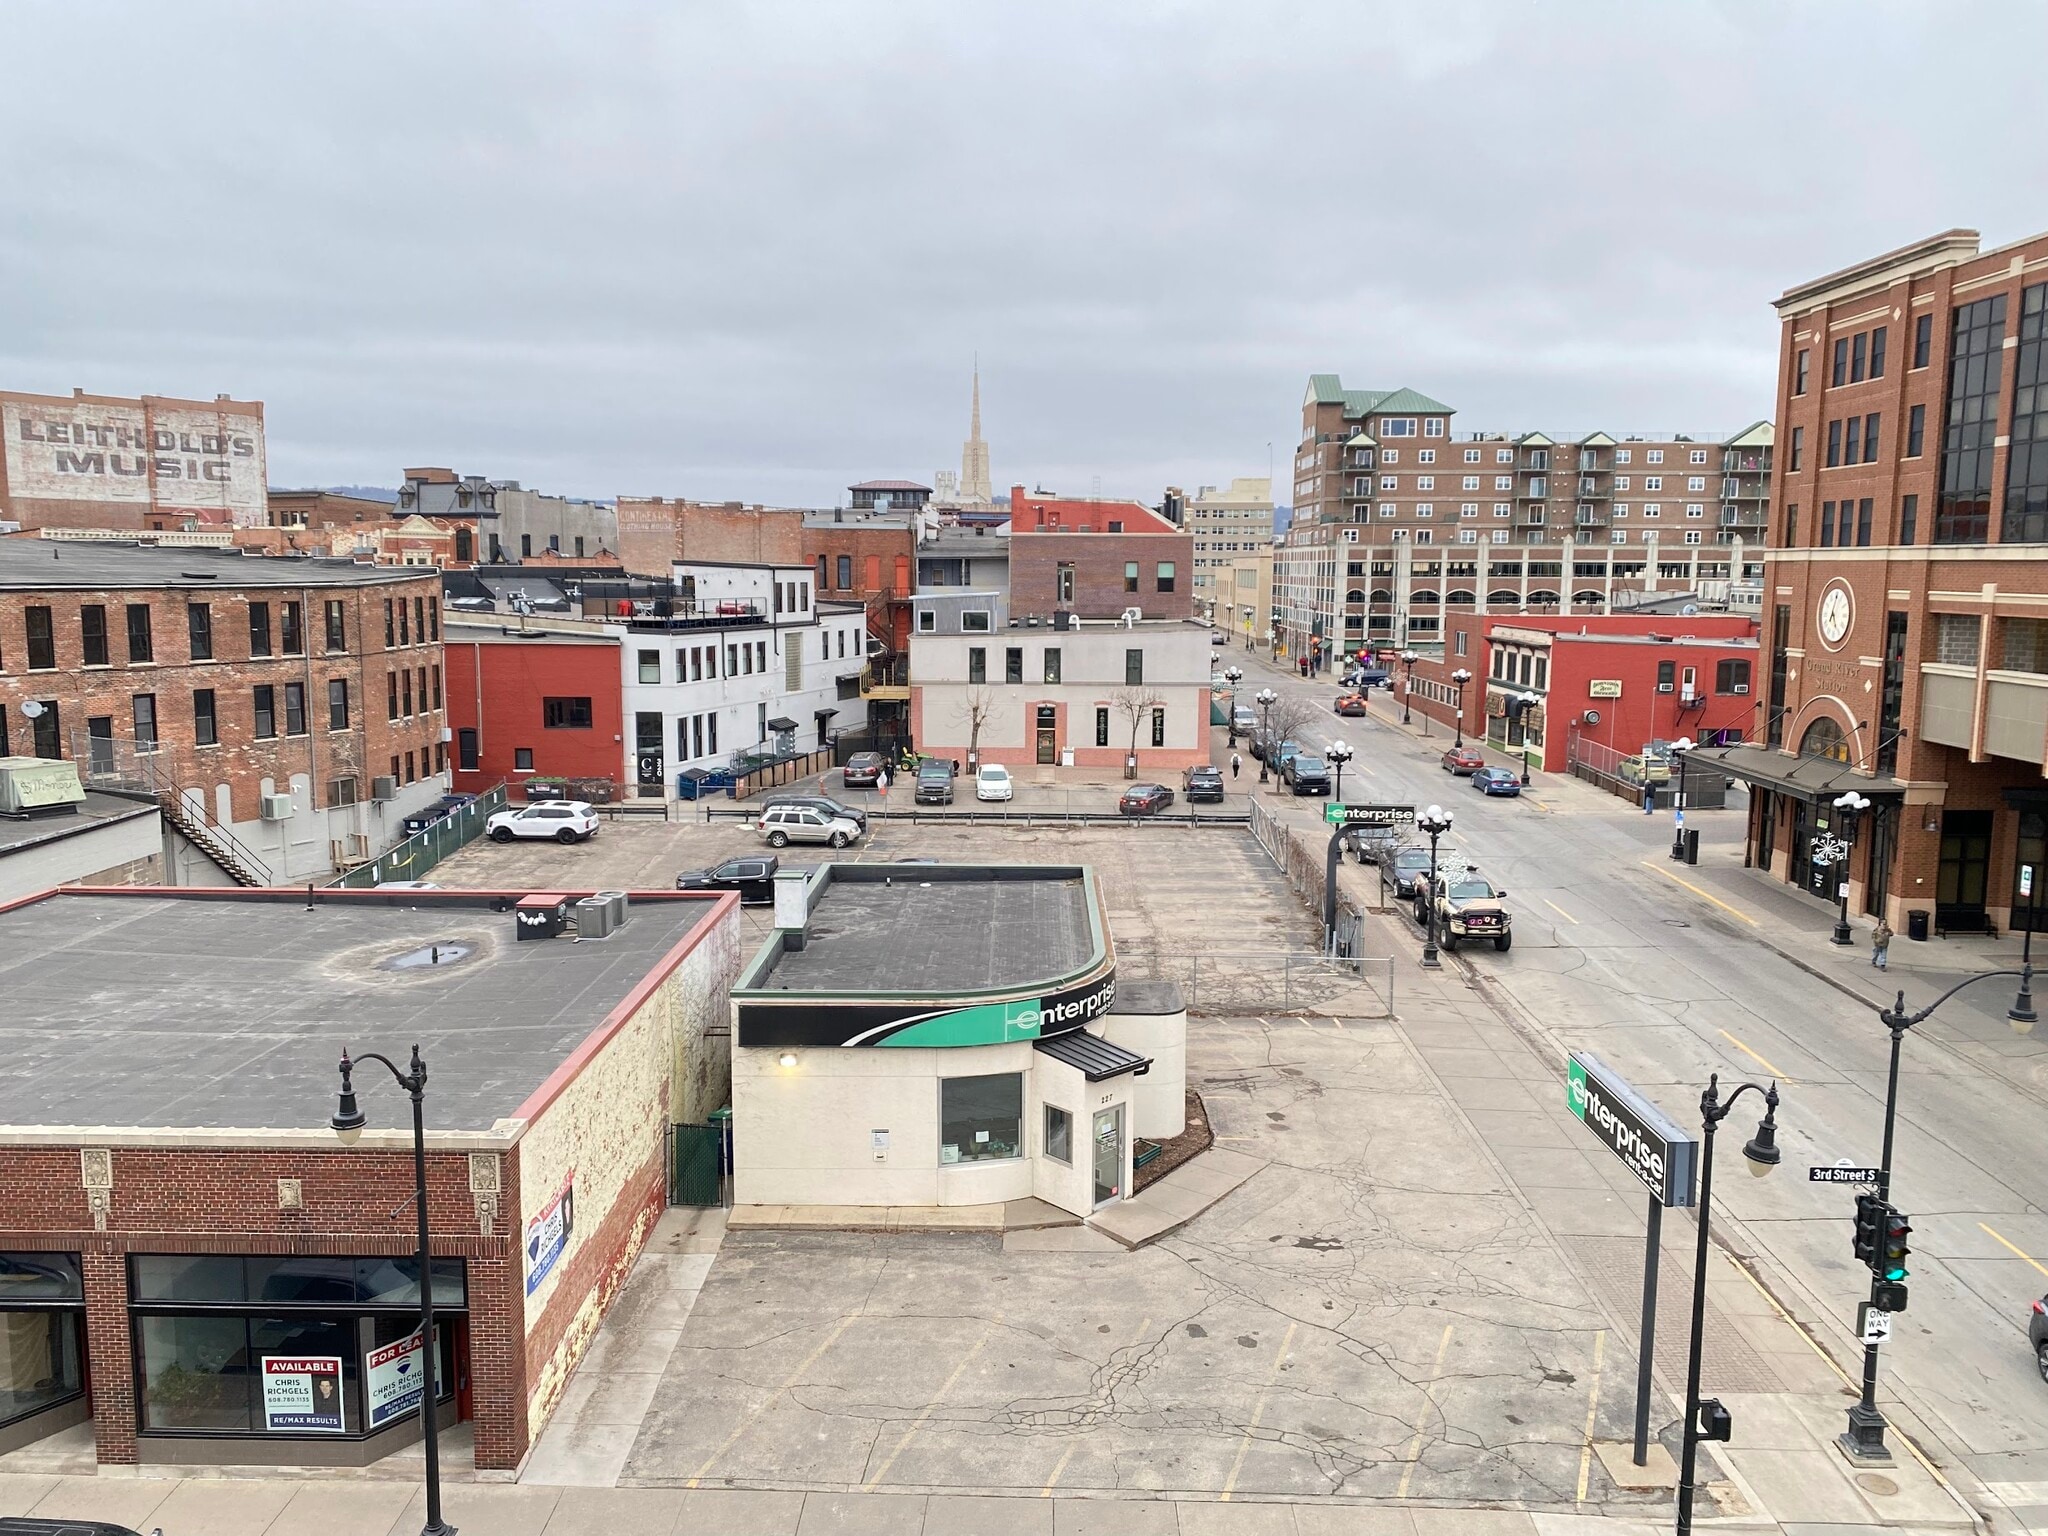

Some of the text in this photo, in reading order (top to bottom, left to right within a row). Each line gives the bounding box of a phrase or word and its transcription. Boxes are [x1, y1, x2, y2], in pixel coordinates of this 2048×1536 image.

[20, 419, 254, 457] LEITHOLD'S
[56, 451, 232, 482] MUSIC
[1332, 808, 1414, 821] enterprise
[1016, 979, 1115, 1029] enterprise
[1572, 1077, 1664, 1180] enterprise
[1625, 1152, 1663, 1195] rent-a-car
[1813, 1168, 1876, 1181] 3rd Street S
[1869, 1310, 1889, 1319] ONE
[1868, 1319, 1889, 1328] WAY
[371, 1348, 396, 1366] FOR
[399, 1338, 423, 1353] LEA
[271, 1362, 334, 1372] AVAILABLE
[373, 1370, 423, 1397] CHRIS RICHG
[267, 1387, 309, 1395] RICHGELS
[384, 1397, 404, 1411] RE/MAX
[273, 1416, 338, 1425] RE/MAX RESULTS
